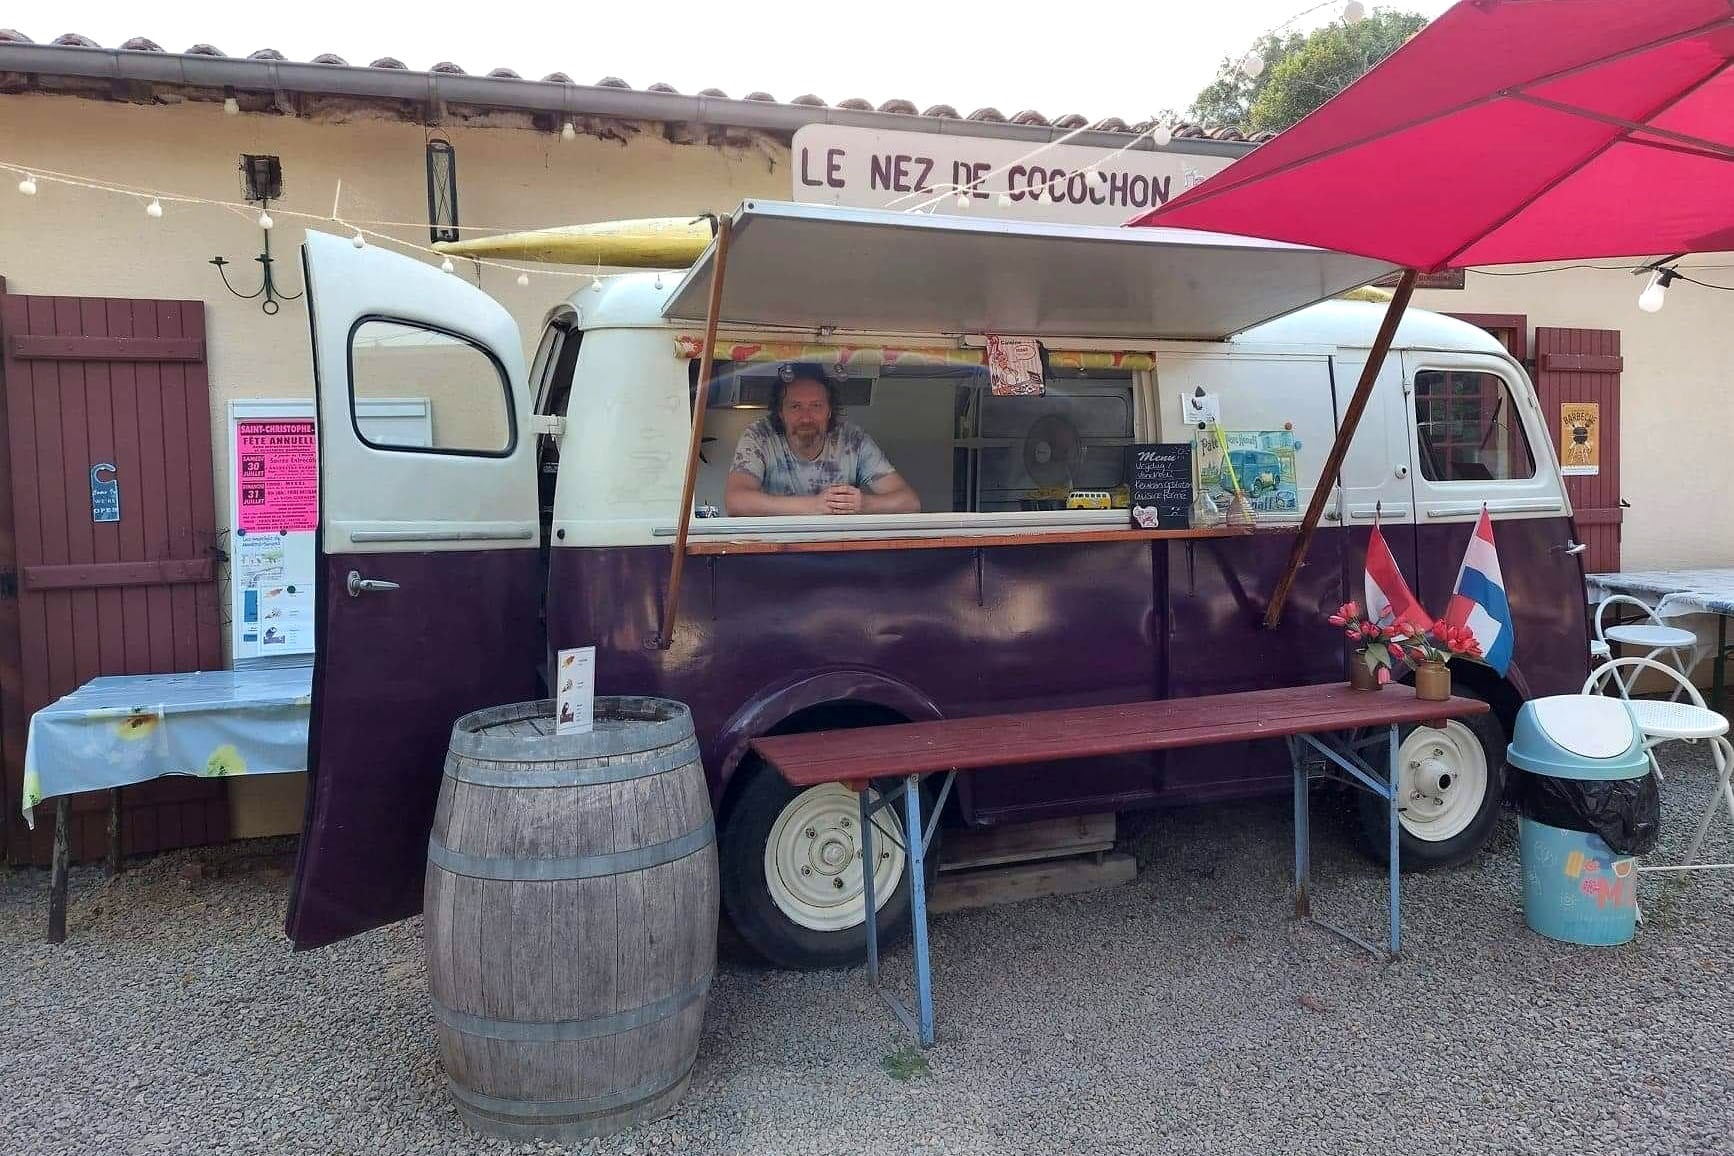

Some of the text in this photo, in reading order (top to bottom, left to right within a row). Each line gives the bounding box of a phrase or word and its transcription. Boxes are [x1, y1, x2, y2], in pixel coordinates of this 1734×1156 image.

[801, 147, 1171, 208] LE NEZ DE COCOCHON
[1138, 452, 1176, 461] Menu
[247, 462, 260, 471] 30
[247, 490, 259, 499] 31
